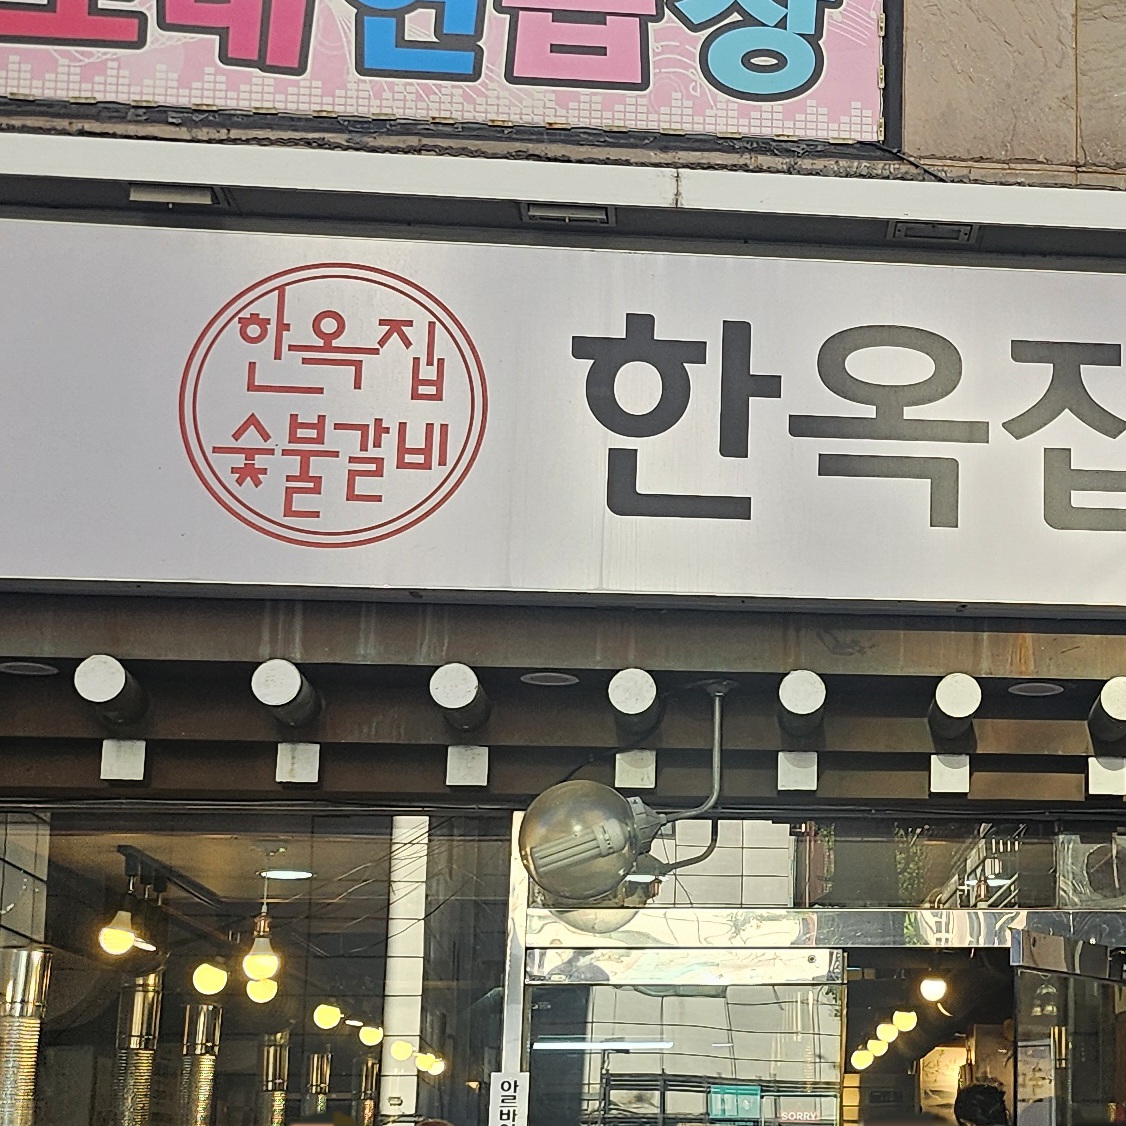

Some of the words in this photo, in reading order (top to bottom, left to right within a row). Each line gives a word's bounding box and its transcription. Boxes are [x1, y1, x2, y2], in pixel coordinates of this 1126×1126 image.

[237, 287, 446, 402] 한옥집
[212, 413, 449, 519] 숯불갈비
[781, 1111, 817, 1121] SORRY
